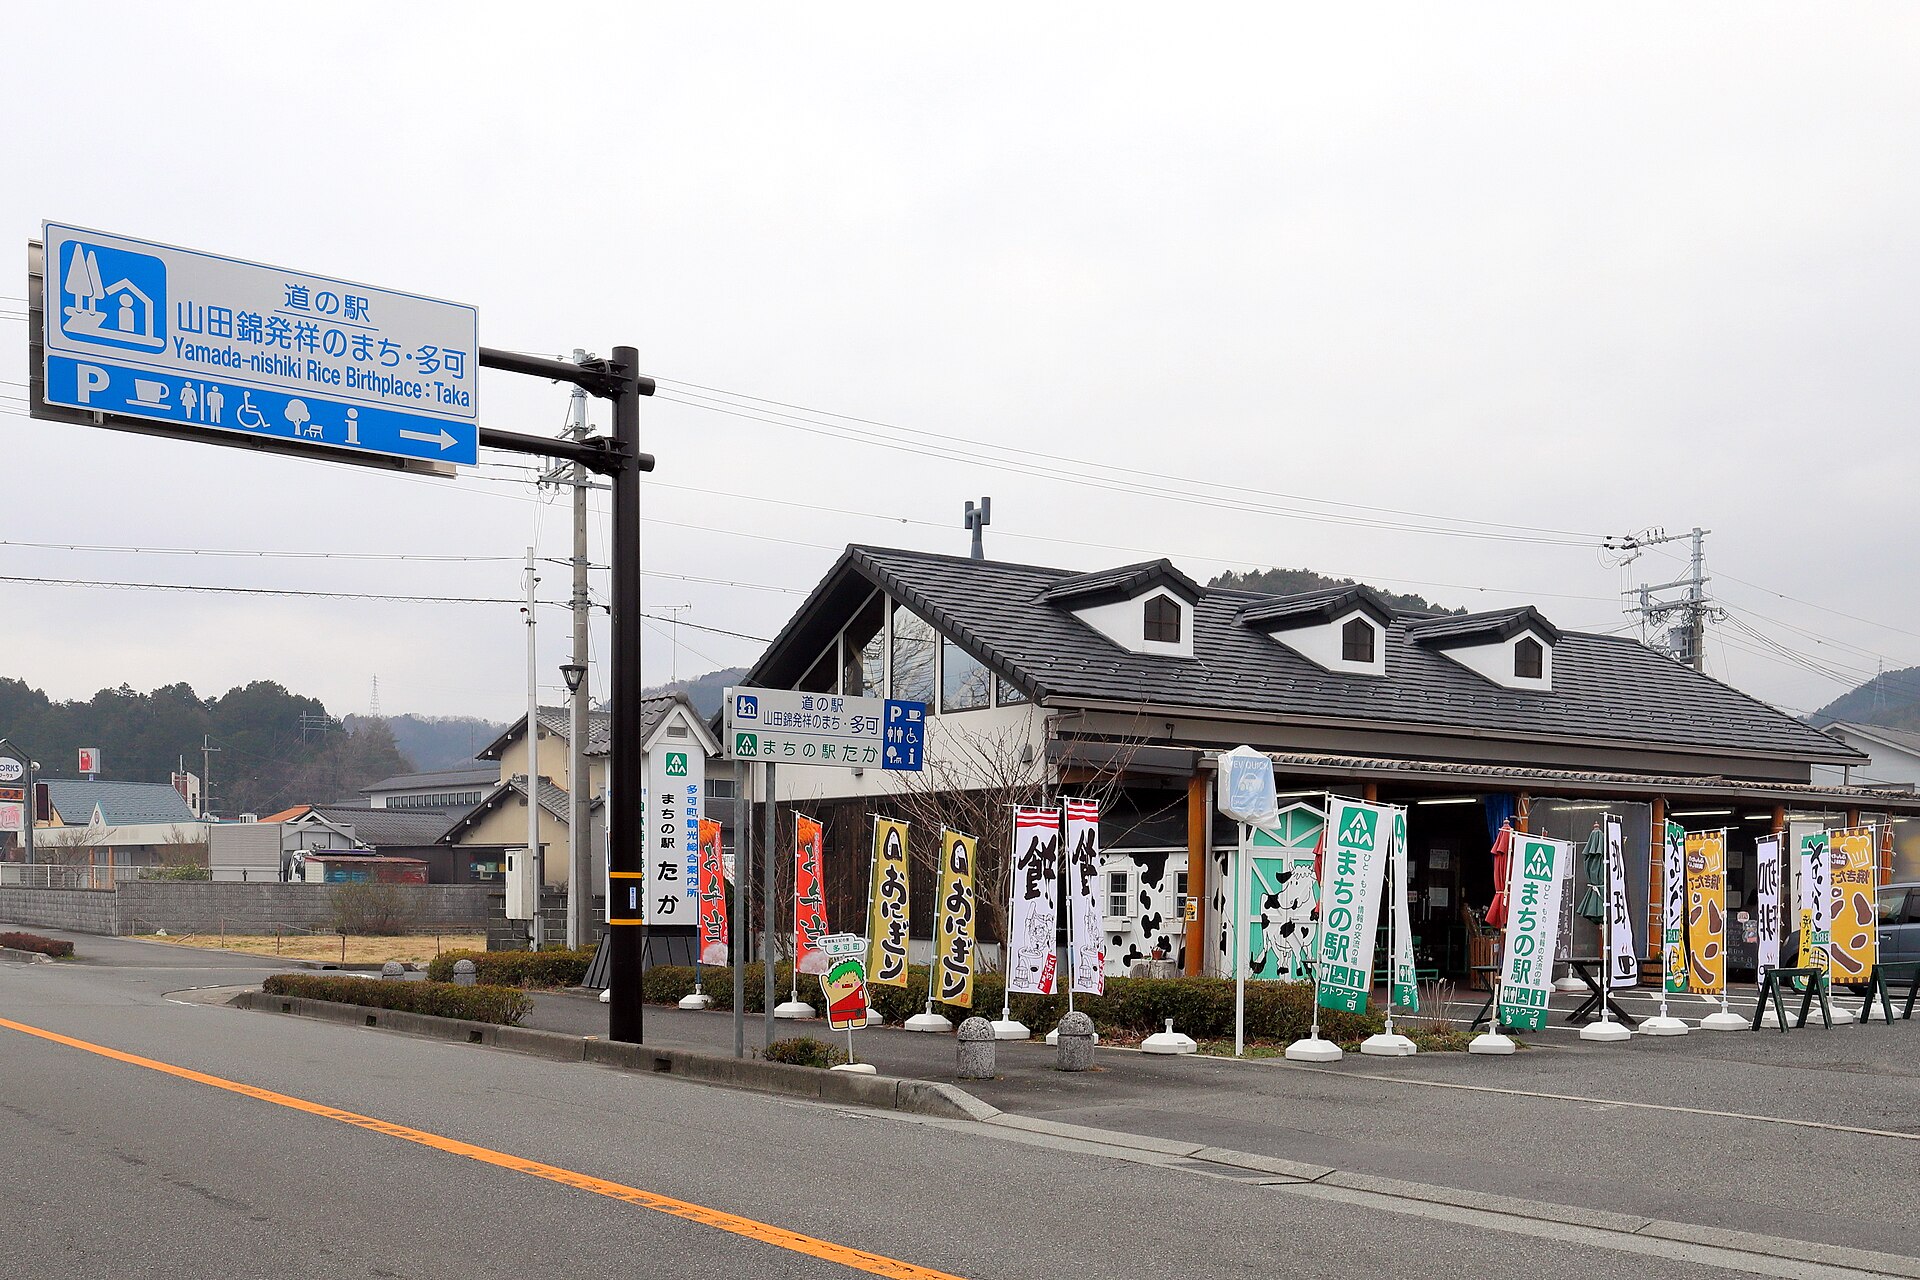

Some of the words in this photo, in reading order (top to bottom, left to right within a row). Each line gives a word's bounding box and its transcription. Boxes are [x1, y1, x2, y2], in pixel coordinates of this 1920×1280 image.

[283, 283, 371, 323] 道の駅
[173, 336, 301, 379] Yamada-nishiki
[306, 358, 341, 385] Rice
[434, 381, 470, 408] Taka
[176, 300, 467, 380] 山田錦発祥のまち・多可
[763, 710, 880, 735] 山田錦発祥のまち・多可
[801, 695, 844, 714] 道の駅
[686, 784, 698, 898] 多可町観光総合案内所
[879, 864, 910, 980] おにぎり
[942, 878, 973, 999] おにぎり
[1322, 850, 1357, 964] まちの駅
[1510, 881, 1539, 985] まちの駅
[832, 943, 860, 953] 多可町
[1346, 1000, 1358, 1011] 可
[1505, 1006, 1540, 1018] ネットワーク
